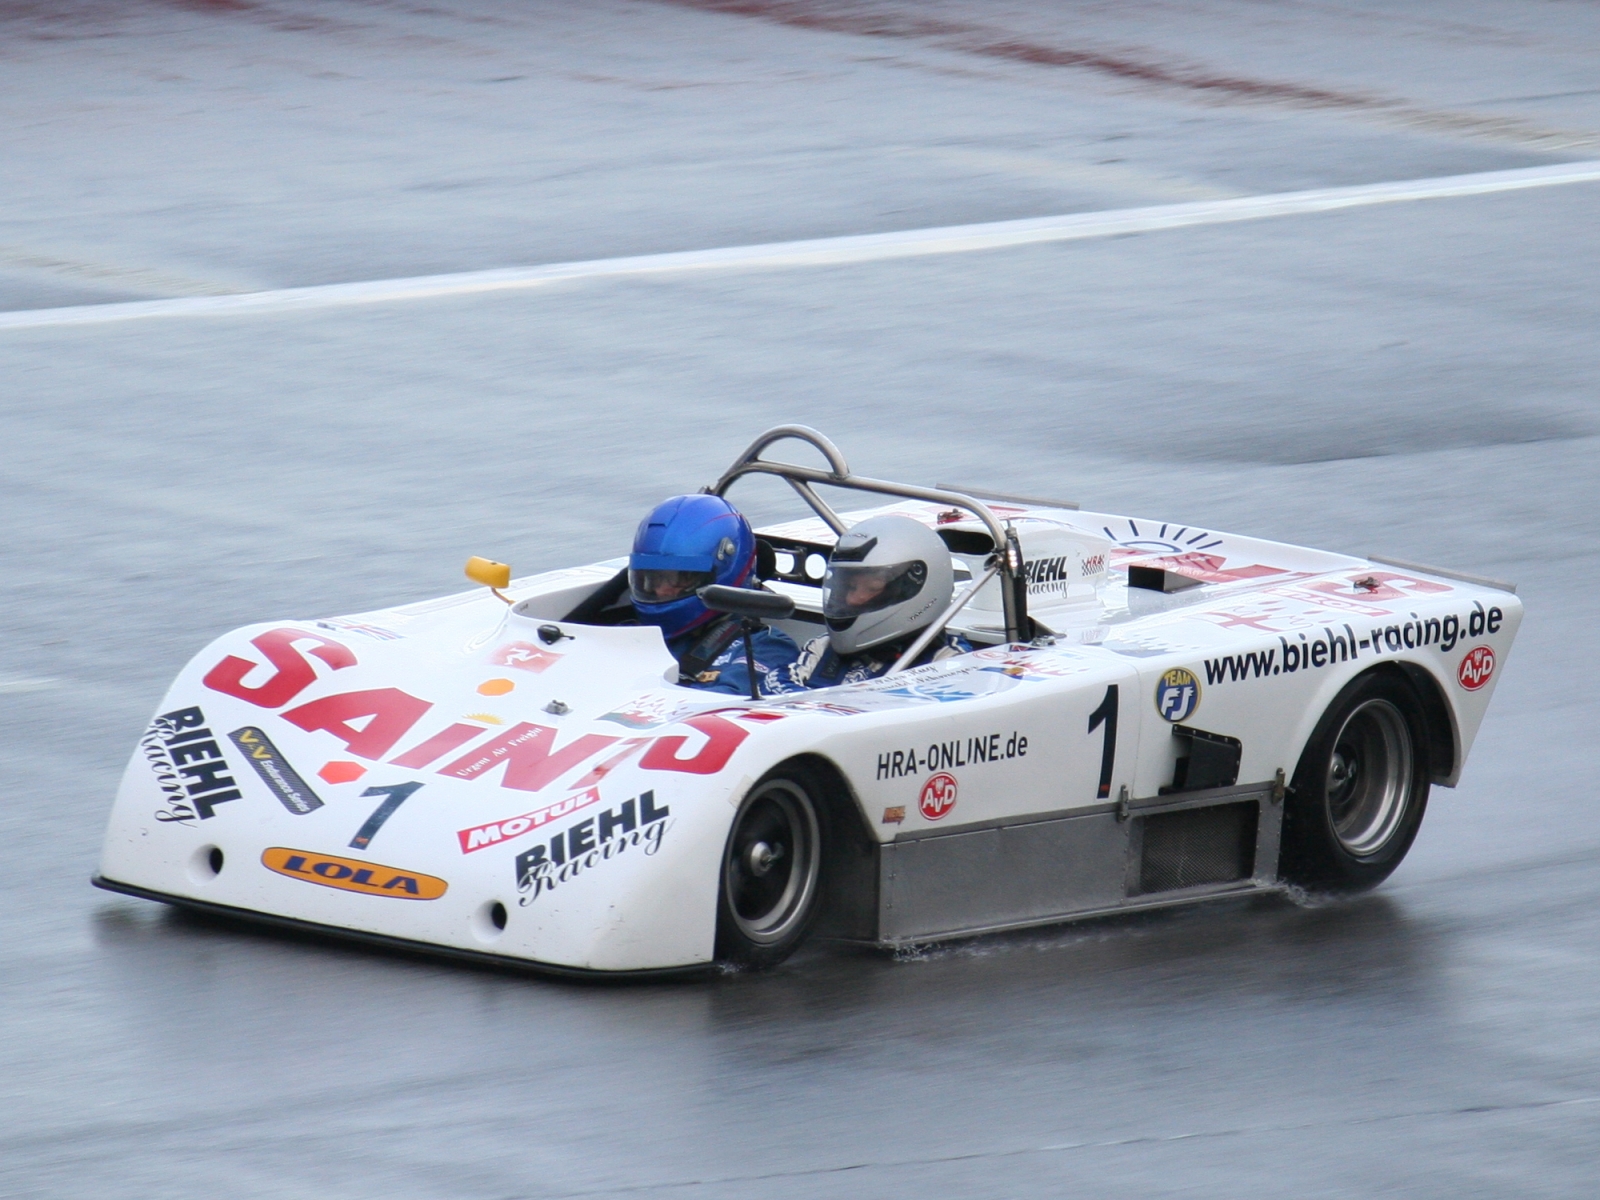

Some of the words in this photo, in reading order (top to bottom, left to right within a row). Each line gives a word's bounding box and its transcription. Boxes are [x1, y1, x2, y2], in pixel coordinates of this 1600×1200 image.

[1203, 601, 1504, 686] www.biehl-racing.de
[1160, 686, 1195, 721] FJ
[1163, 670, 1191, 687] TEAM
[140, 716, 197, 828] Racing
[154, 705, 243, 820] BIEHL
[455, 756, 491, 778] Urgent
[493, 744, 509, 758] Air
[509, 727, 543, 749] Freight
[876, 731, 1029, 781] HRA-ONLINE.de
[1087, 684, 1119, 799] 1
[259, 759, 293, 794] Endurance
[347, 780, 426, 850] 1
[467, 793, 594, 850] MOTUL
[515, 789, 670, 888] BIEHL
[282, 855, 420, 895] LOLA
[518, 816, 677, 907] Racing
